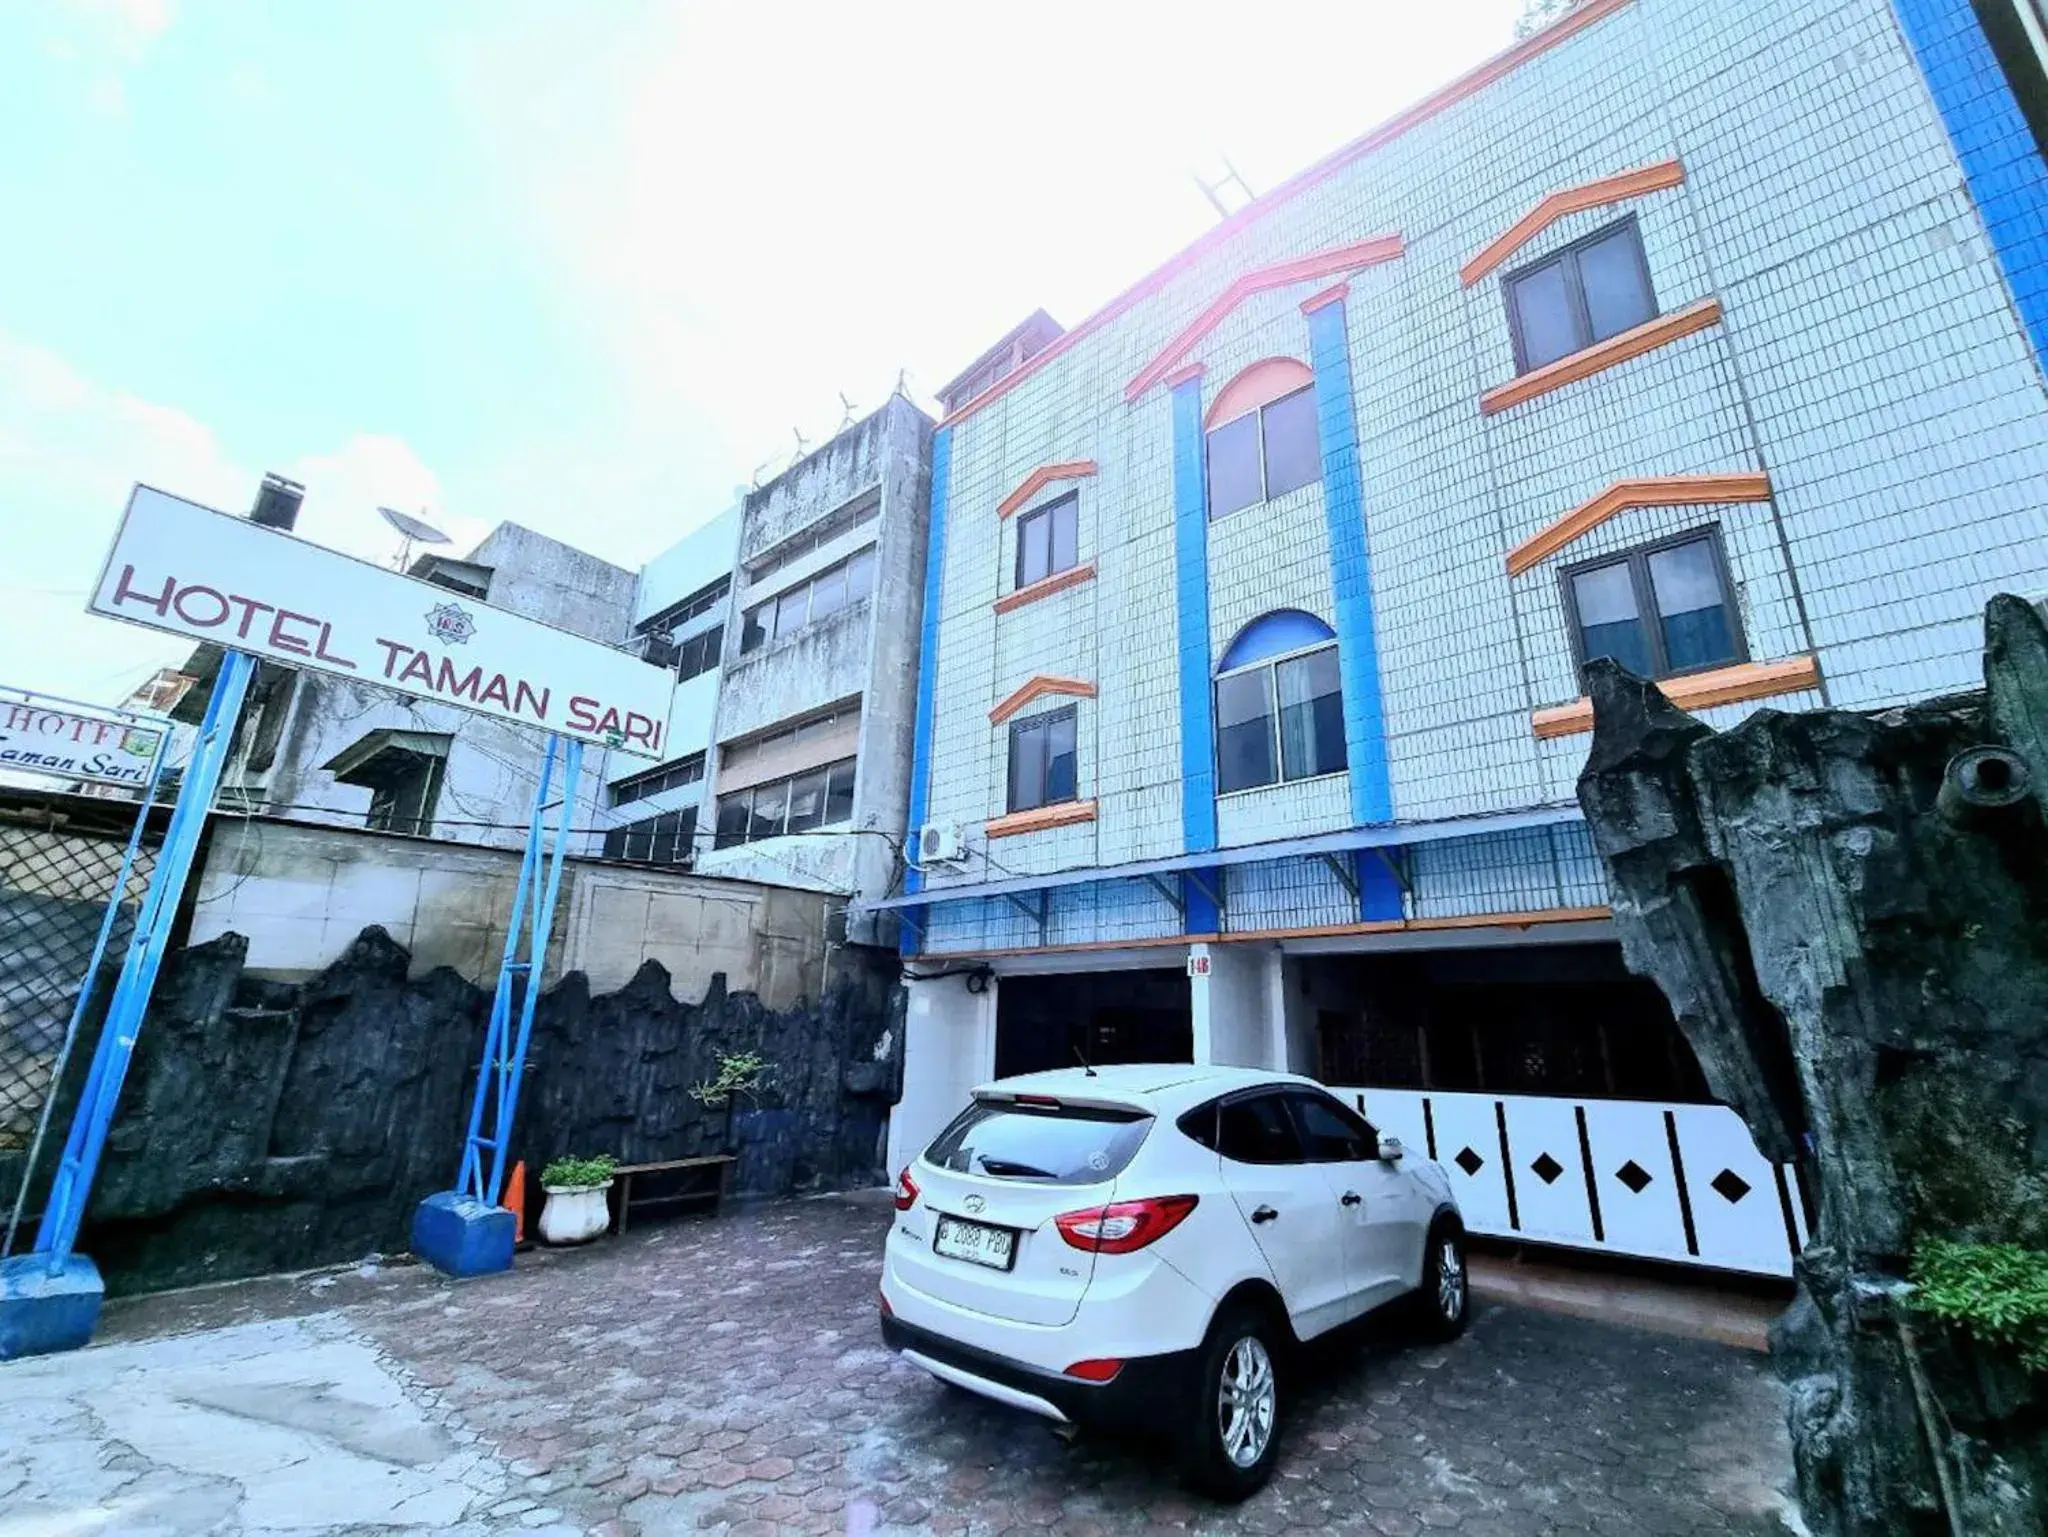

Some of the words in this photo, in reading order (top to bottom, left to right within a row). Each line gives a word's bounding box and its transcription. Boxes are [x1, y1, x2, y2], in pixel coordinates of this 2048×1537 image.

[112, 564, 357, 669] HOTEL
[376, 638, 550, 720] TAMAN
[565, 696, 662, 750] SARI
[0, 736, 75, 770] aman
[81, 753, 146, 781] Sari
